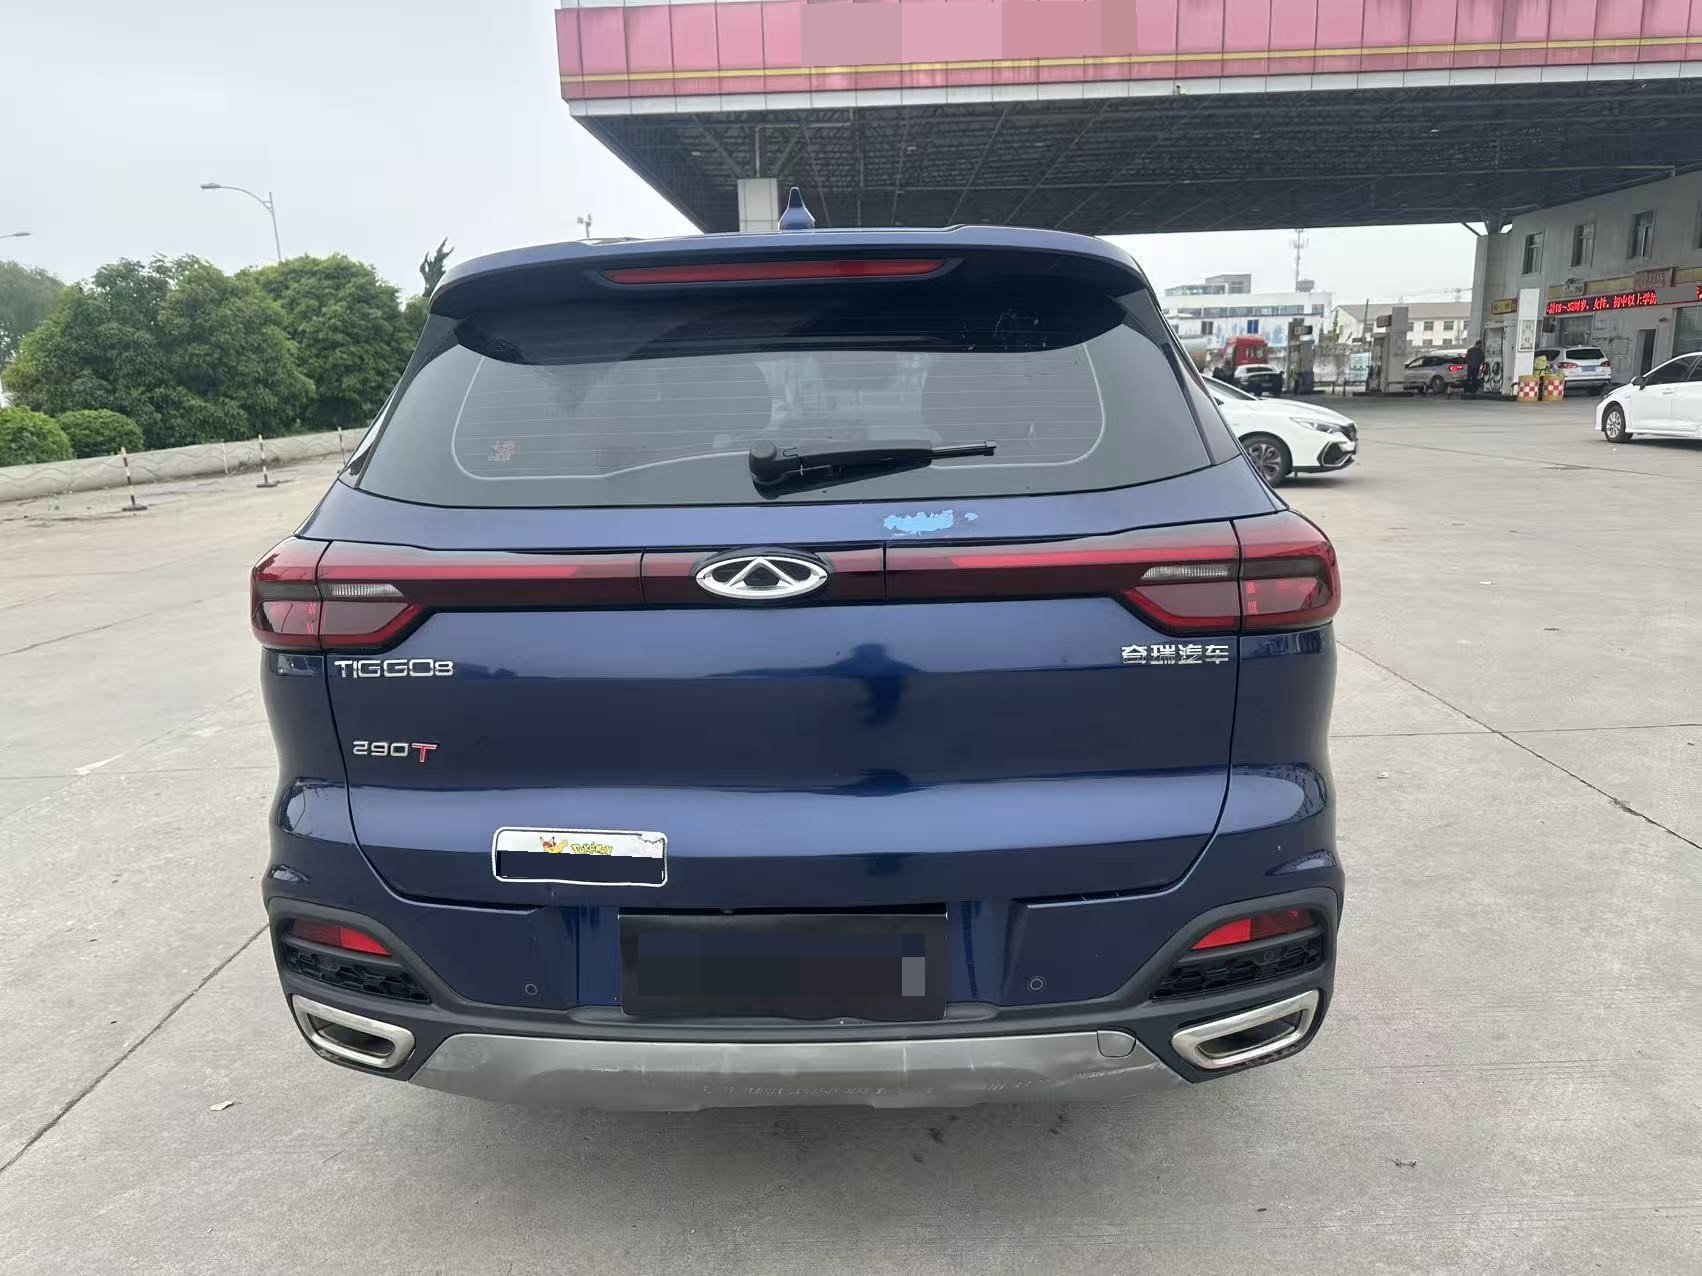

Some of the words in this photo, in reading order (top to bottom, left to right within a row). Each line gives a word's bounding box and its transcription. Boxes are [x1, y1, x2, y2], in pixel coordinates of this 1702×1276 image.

[1121, 644, 1229, 665] 奇瑞汽车
[353, 741, 438, 763] 290T
